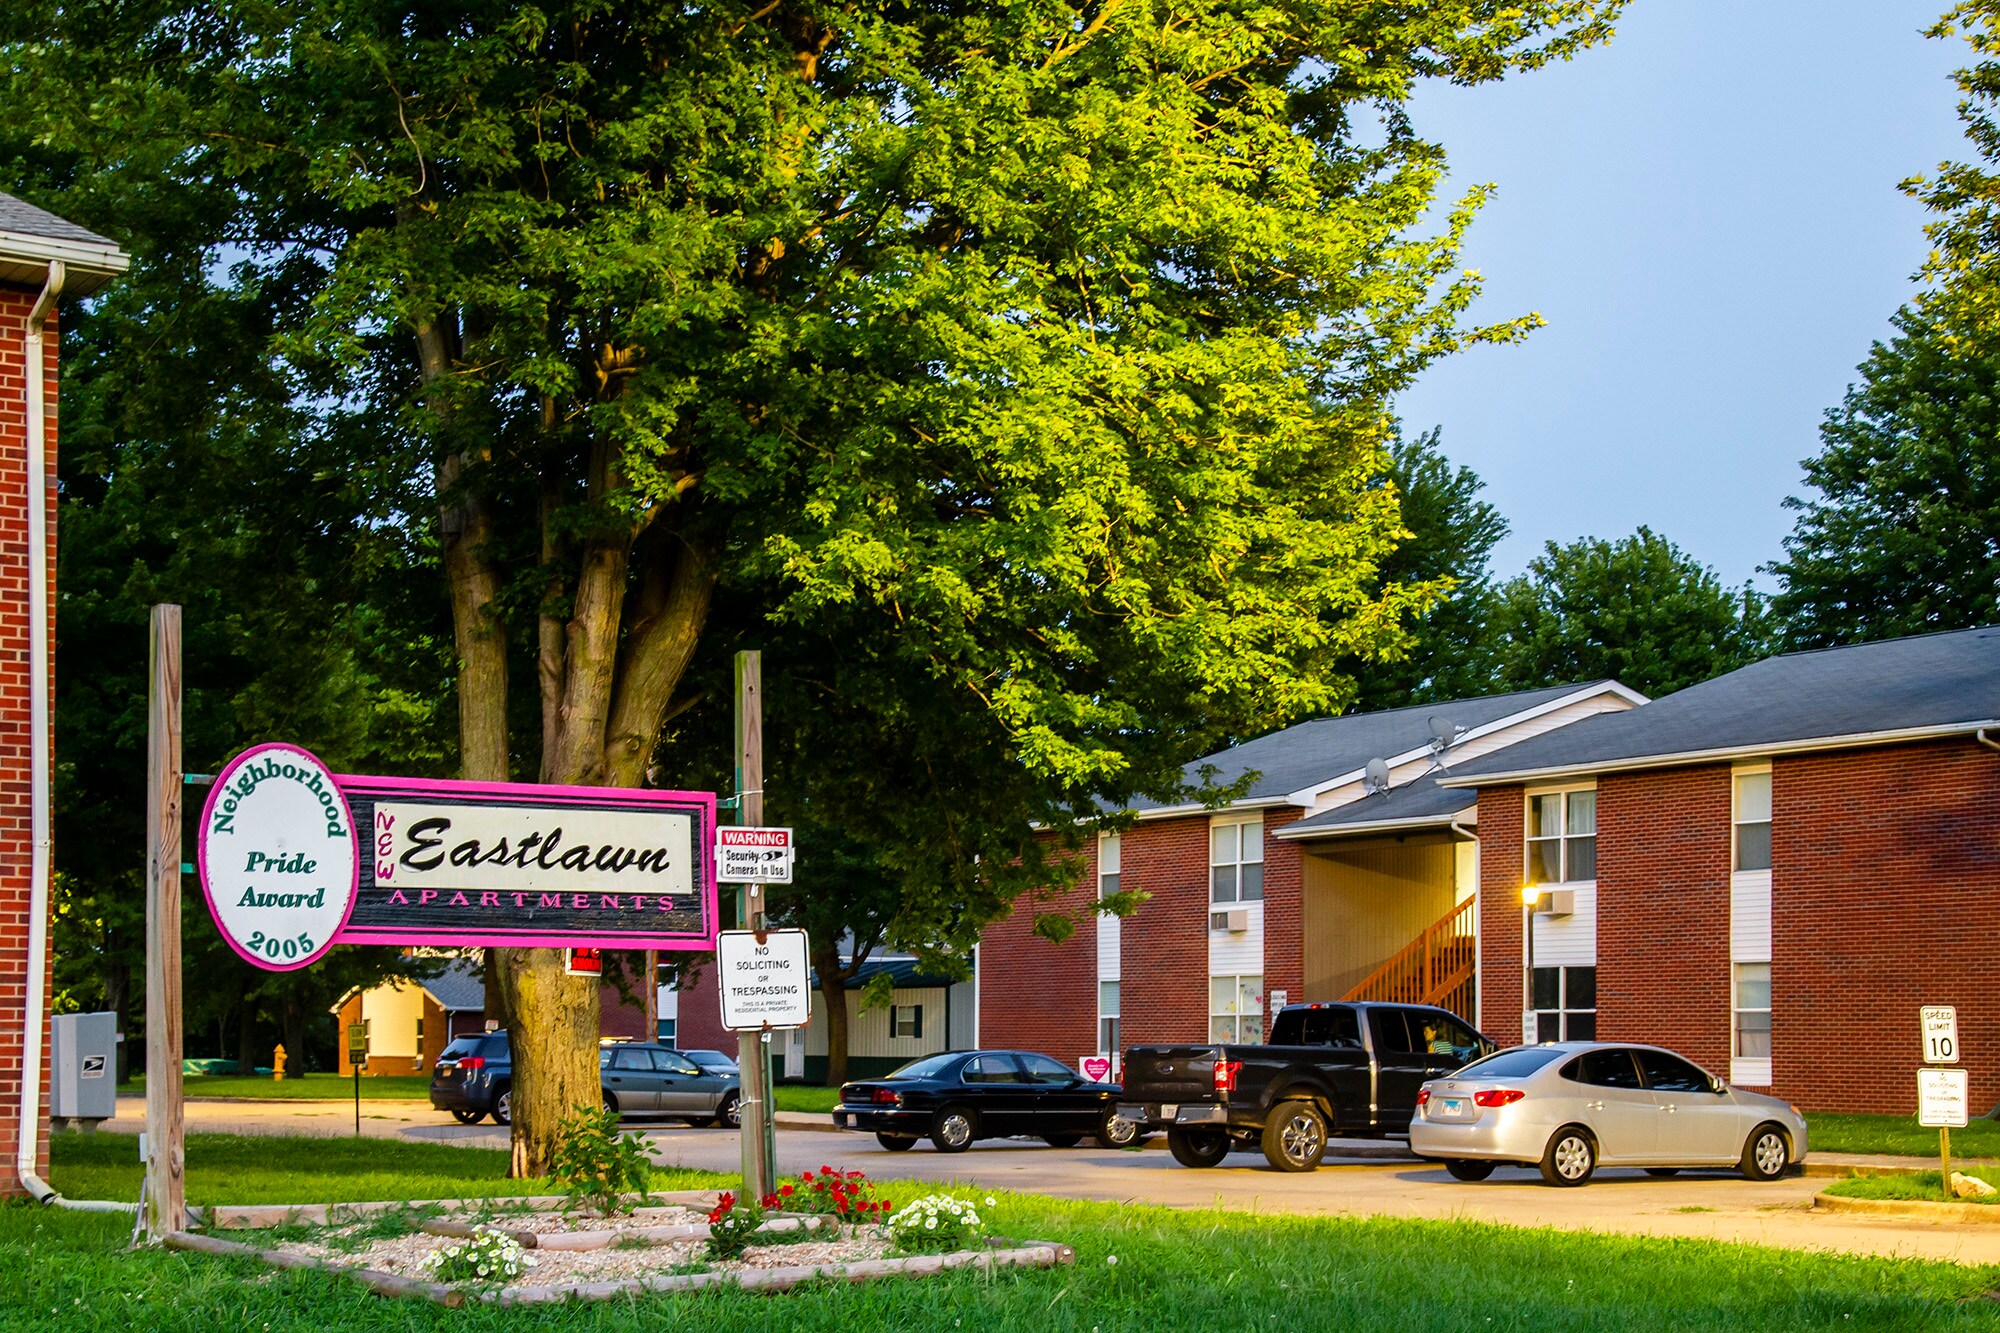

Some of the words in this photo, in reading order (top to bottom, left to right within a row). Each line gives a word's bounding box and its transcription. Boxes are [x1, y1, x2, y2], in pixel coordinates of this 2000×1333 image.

[214, 757, 347, 838] Neighborhood
[376, 810, 396, 881] NEW
[400, 817, 670, 874] Eastlawn
[724, 831, 785, 845] WARNING
[244, 851, 317, 874] Pride
[726, 849, 760, 864] Security
[726, 863, 759, 876] Cameras
[761, 864, 769, 875] In
[770, 865, 784, 876] Use
[237, 886, 325, 909] Award
[388, 889, 674, 911] APARTMENTS
[246, 930, 314, 959] 2005
[754, 946, 770, 956] NO
[736, 960, 790, 971] SOLICITING
[757, 975, 769, 983] OR
[731, 985, 798, 997] TRESPASSING
[1925, 1011, 1952, 1020] SPEED
[1929, 1023, 1951, 1031] LIMIT
[1931, 1037, 1952, 1057] 10
